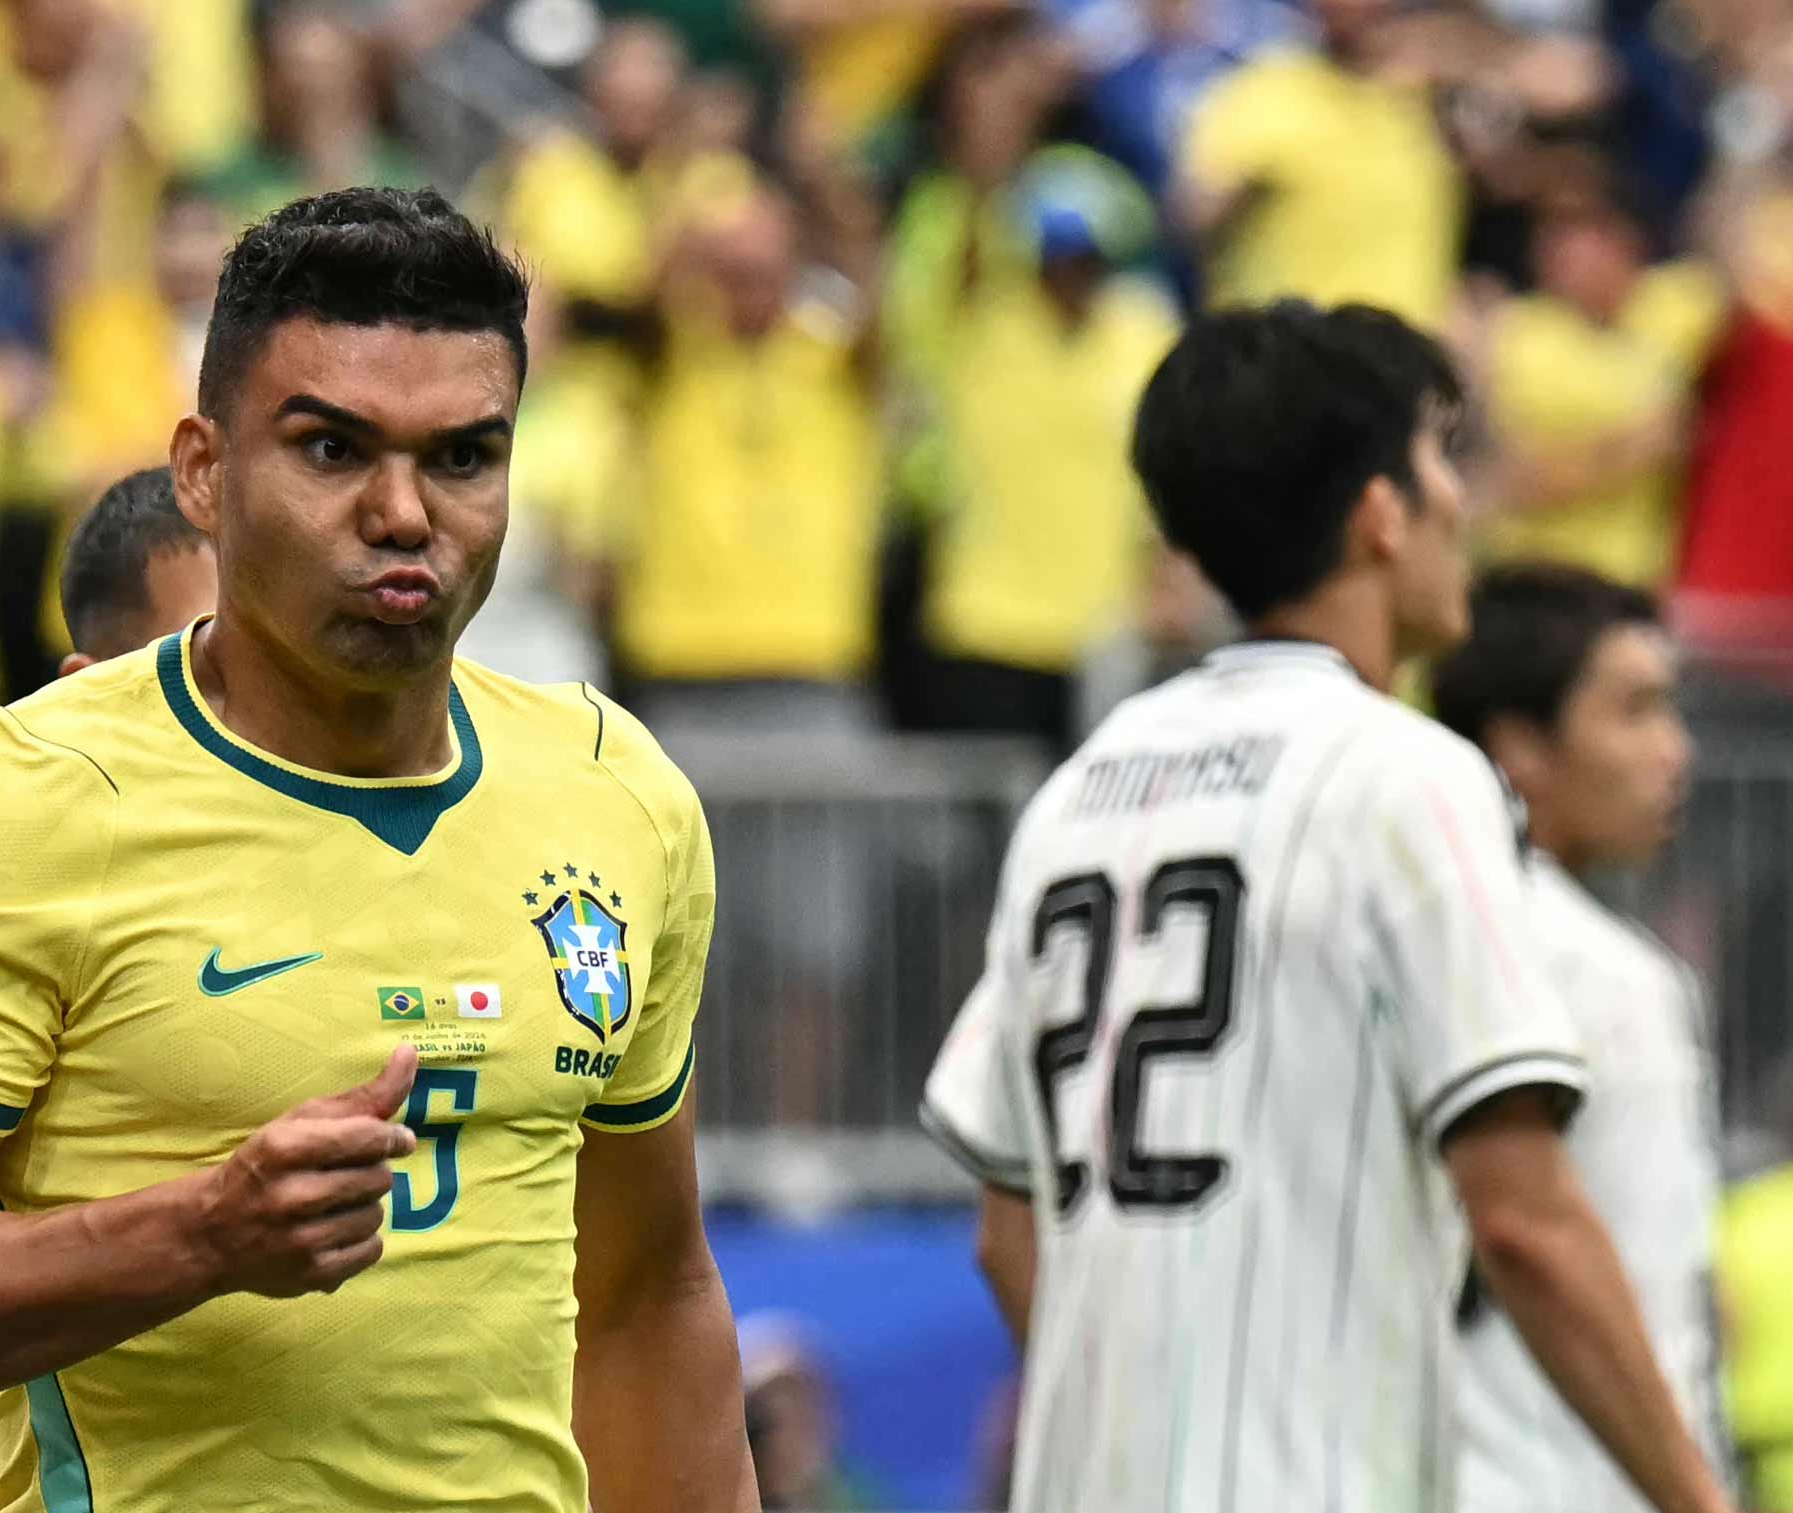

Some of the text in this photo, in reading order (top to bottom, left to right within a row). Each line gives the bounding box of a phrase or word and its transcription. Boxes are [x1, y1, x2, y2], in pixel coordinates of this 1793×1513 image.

[576, 950, 609, 968] CBF
[1030, 854, 1248, 1214] 22
[388, 1066, 480, 1233] 5
